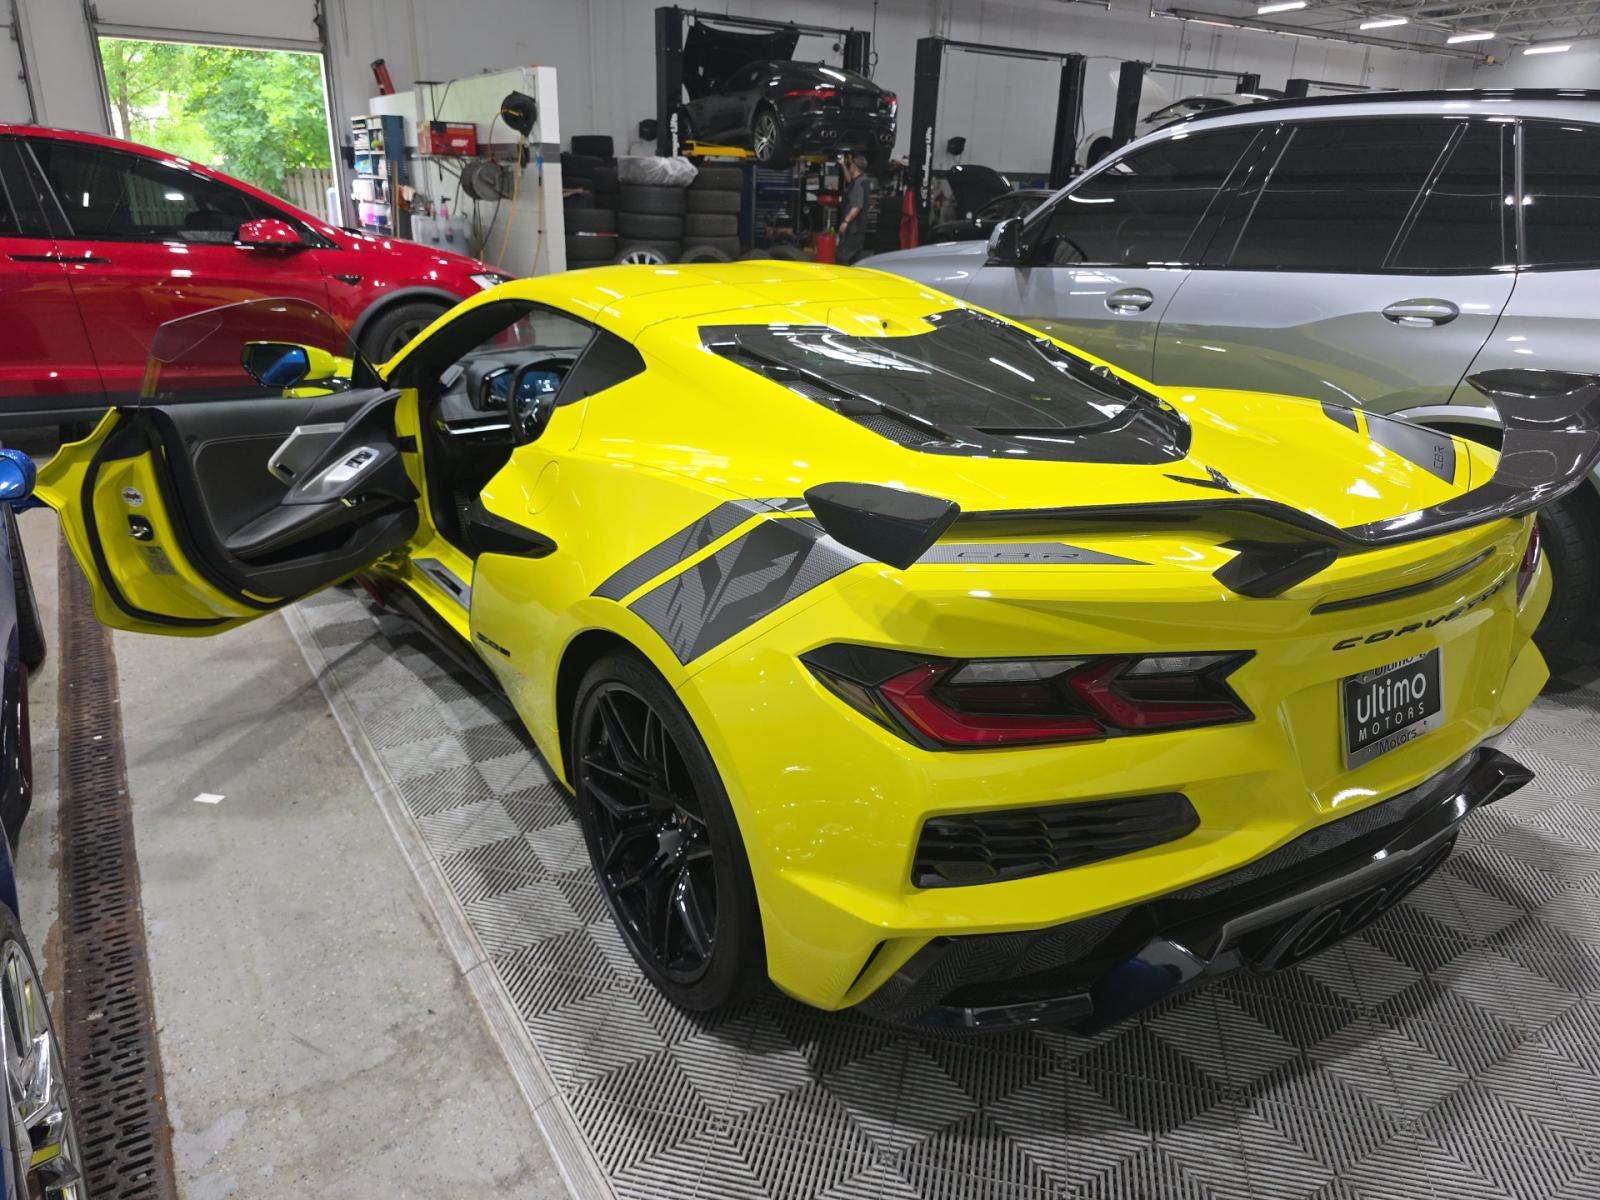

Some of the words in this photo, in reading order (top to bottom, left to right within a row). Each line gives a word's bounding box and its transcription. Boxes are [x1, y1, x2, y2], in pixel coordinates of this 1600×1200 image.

[1332, 580, 1504, 651] CORVETTE
[1359, 702, 1424, 742] MOTORS
[1379, 729, 1417, 753] Motors
